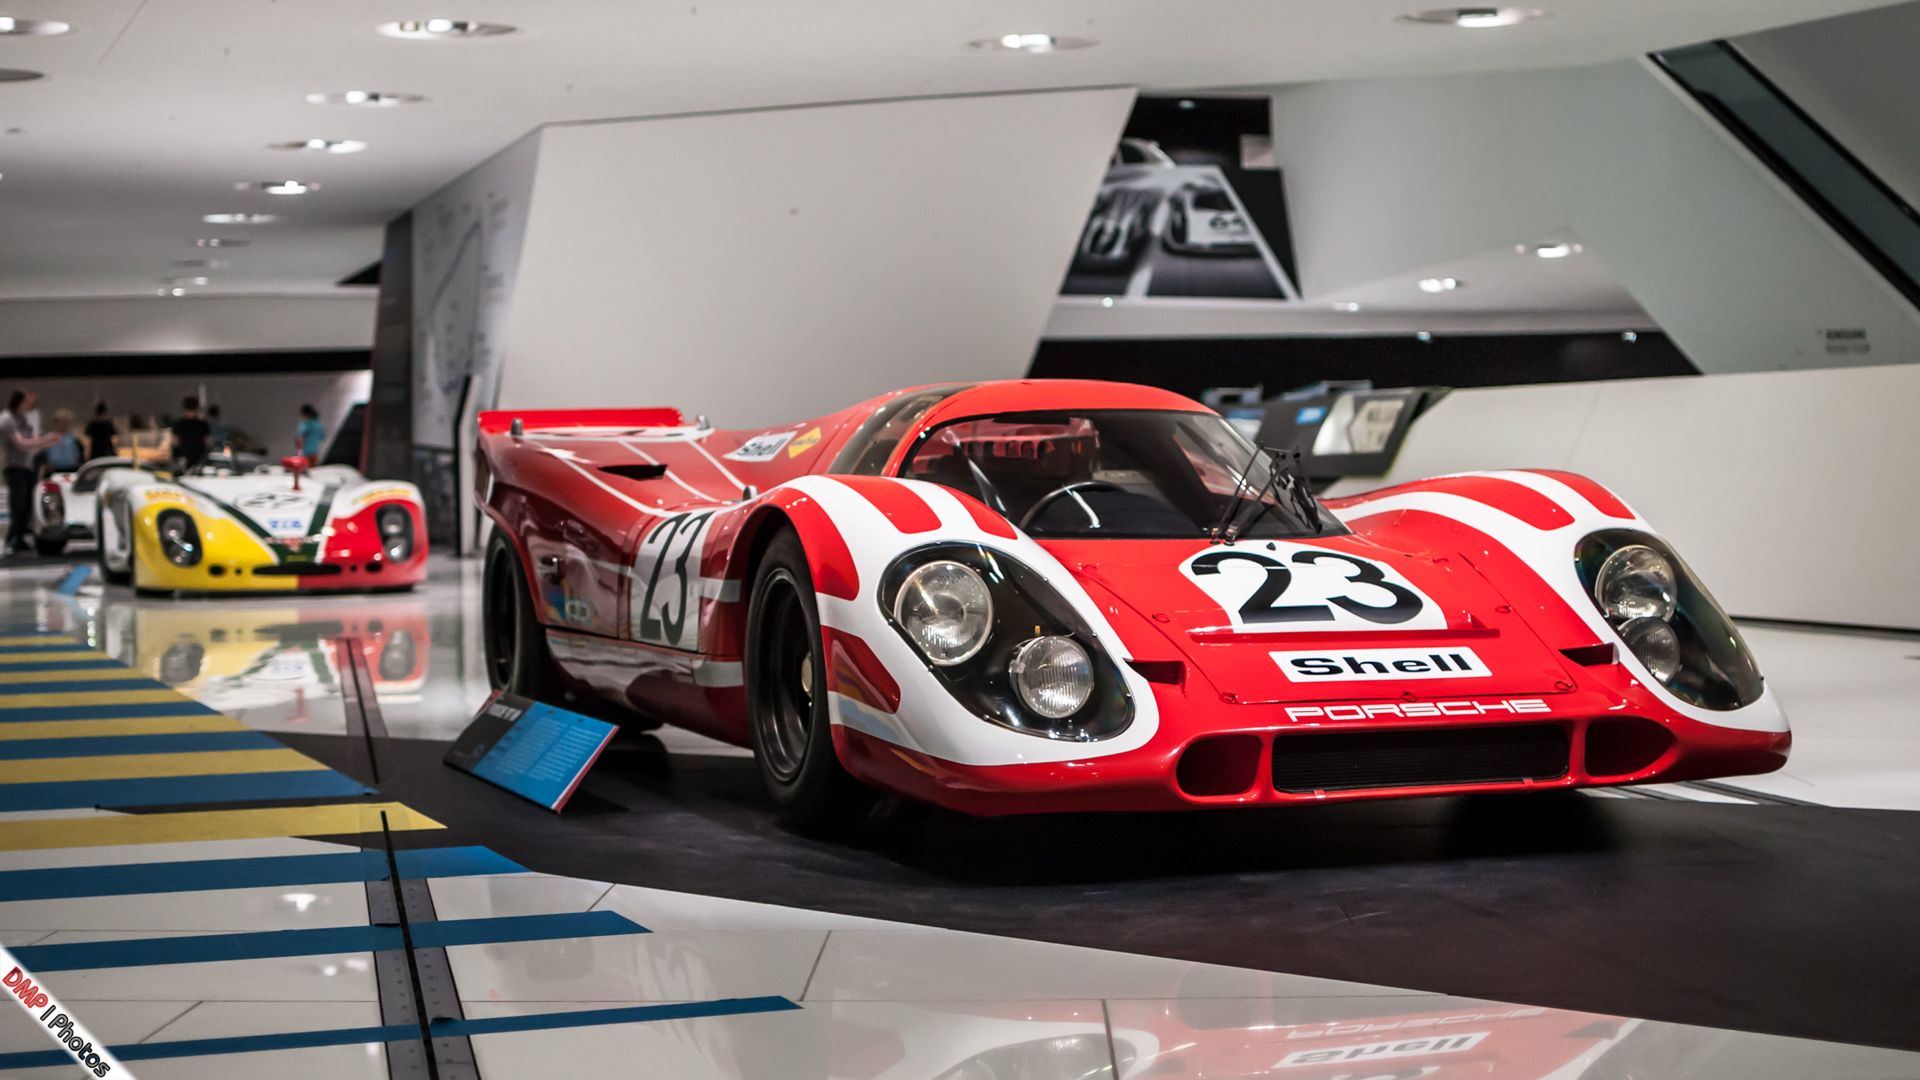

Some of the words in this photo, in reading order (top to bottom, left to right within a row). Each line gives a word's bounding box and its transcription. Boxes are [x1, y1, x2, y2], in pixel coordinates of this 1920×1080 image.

[736, 437, 788, 457] Shell
[640, 511, 716, 646] 23
[1191, 550, 1424, 625] 23
[1290, 653, 1473, 676] Shell
[1284, 698, 1552, 722] PORSCHE
